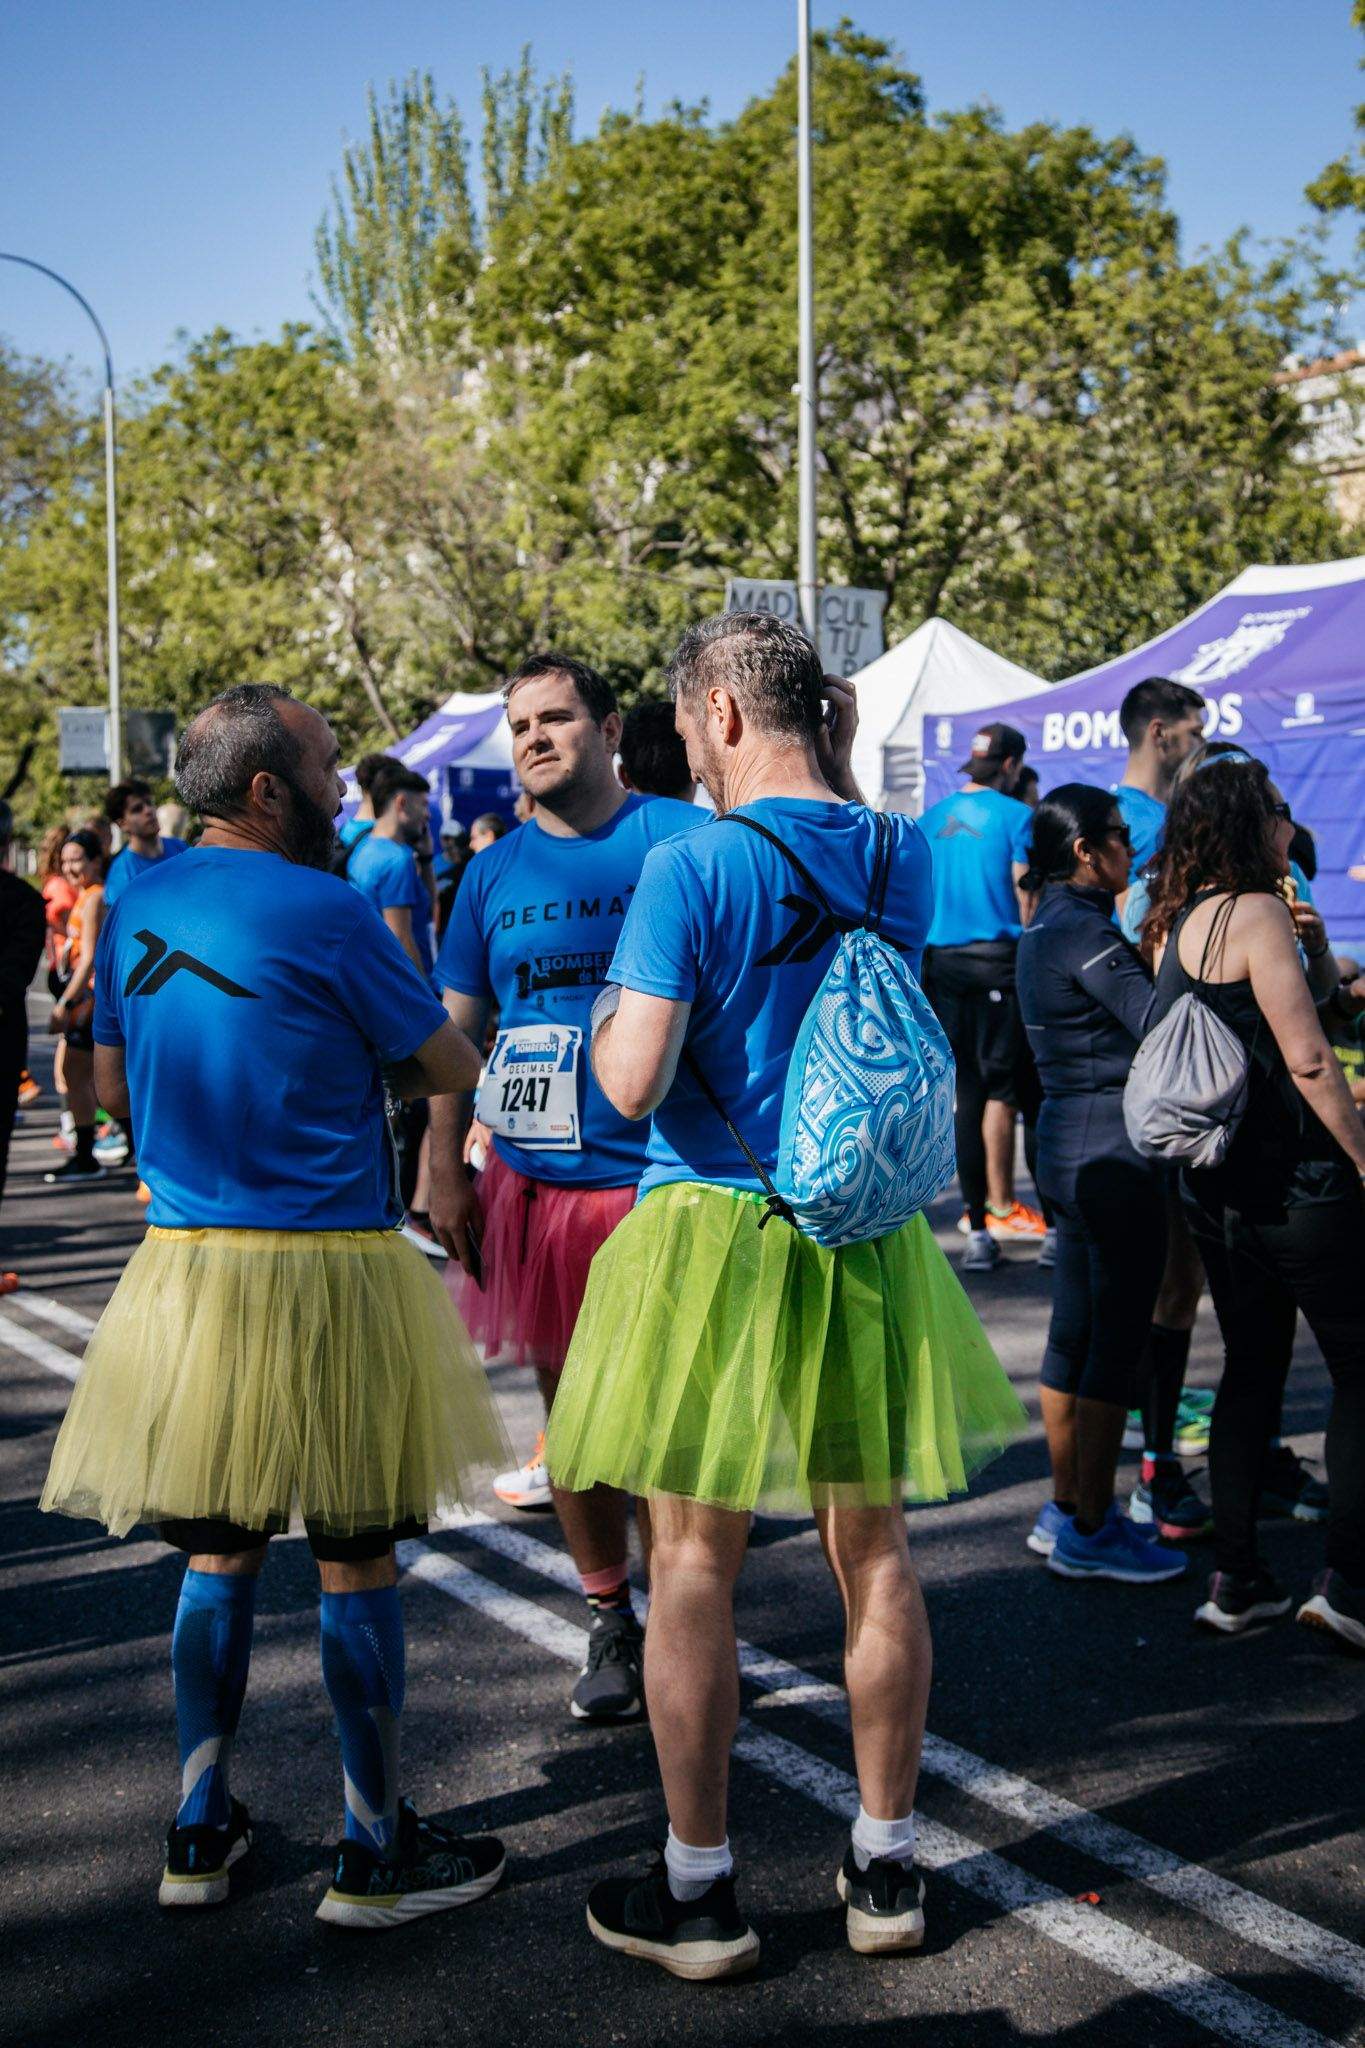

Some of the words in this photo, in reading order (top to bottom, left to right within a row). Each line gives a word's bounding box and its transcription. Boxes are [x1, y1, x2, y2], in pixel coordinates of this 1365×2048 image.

[824, 595, 868, 628] CUL
[829, 627, 862, 657] TU
[1042, 692, 1244, 753] BOMOS
[501, 896, 624, 931] DECIMA
[515, 1042, 558, 1054] BOMBEROS
[509, 1063, 554, 1075] DECIMAS
[500, 1077, 551, 1113] 1247
